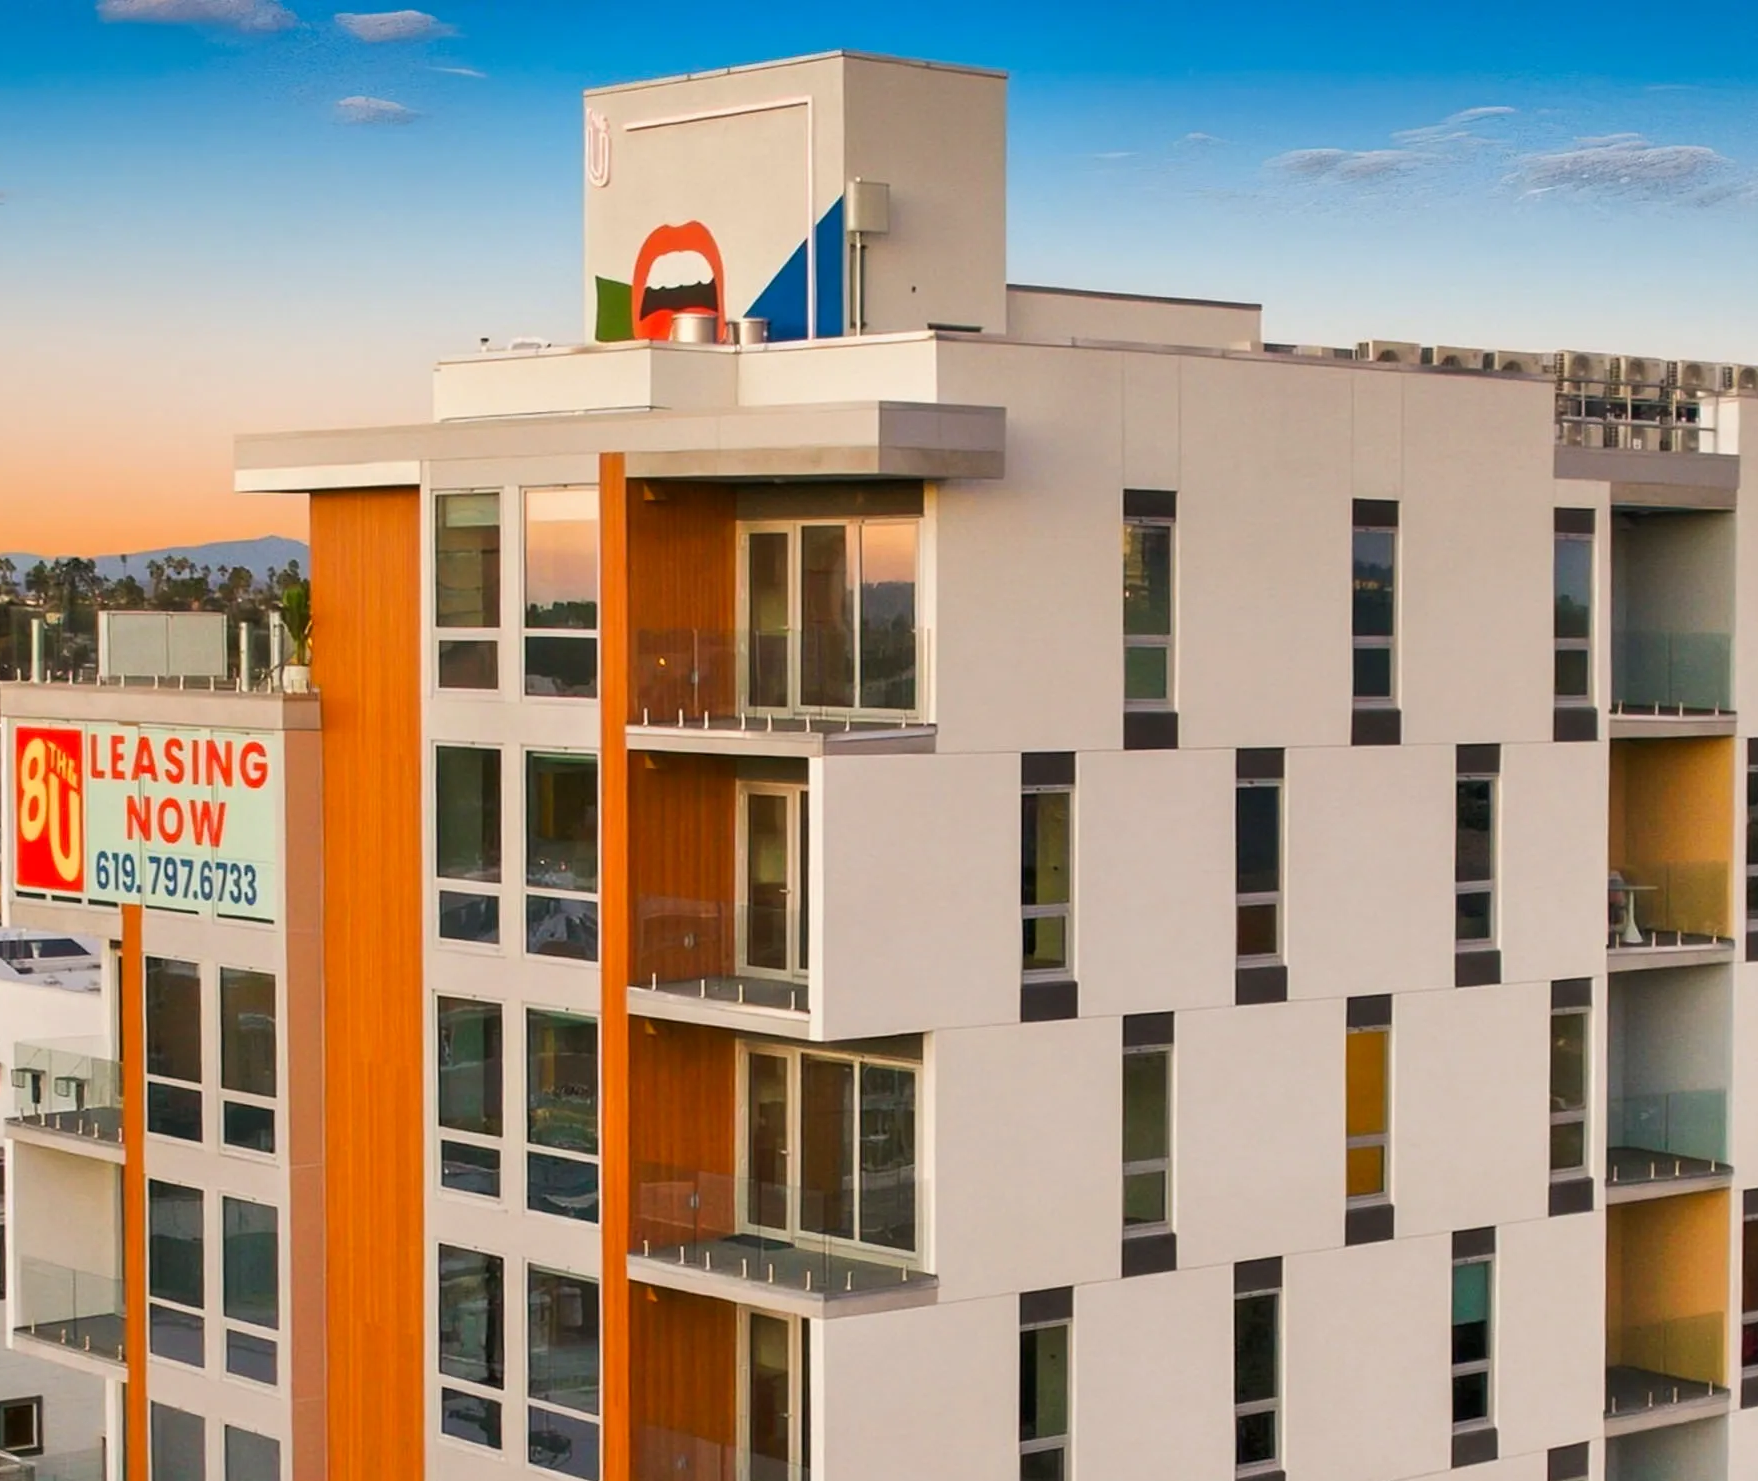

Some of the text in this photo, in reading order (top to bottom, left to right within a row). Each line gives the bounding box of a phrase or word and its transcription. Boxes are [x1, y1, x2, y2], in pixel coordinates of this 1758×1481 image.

[46, 741, 79, 788] THE
[90, 734, 268, 789] LEASING
[126, 795, 226, 847] NOW
